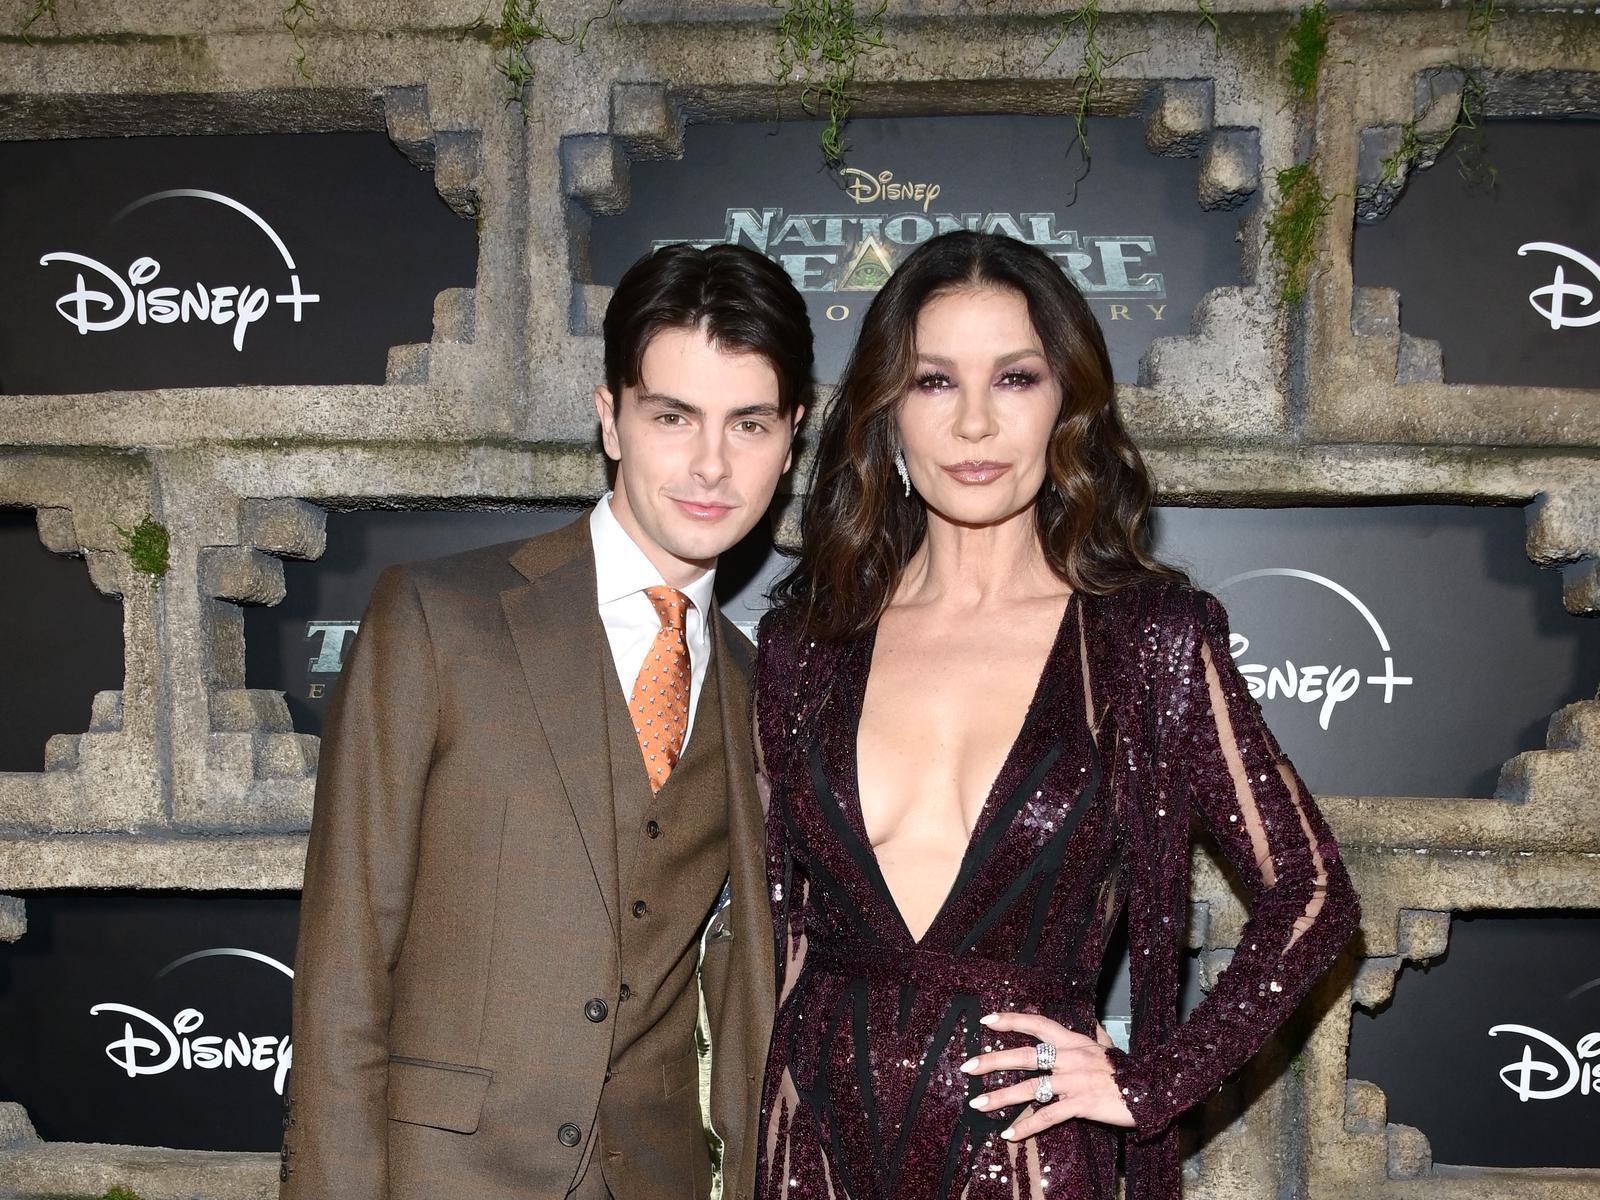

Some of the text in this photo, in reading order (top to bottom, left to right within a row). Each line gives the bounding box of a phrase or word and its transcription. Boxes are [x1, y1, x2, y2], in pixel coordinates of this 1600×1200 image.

[840, 167, 941, 213] Disney
[1229, 632, 1413, 731] sney+
[90, 1002, 293, 1096] Disney
